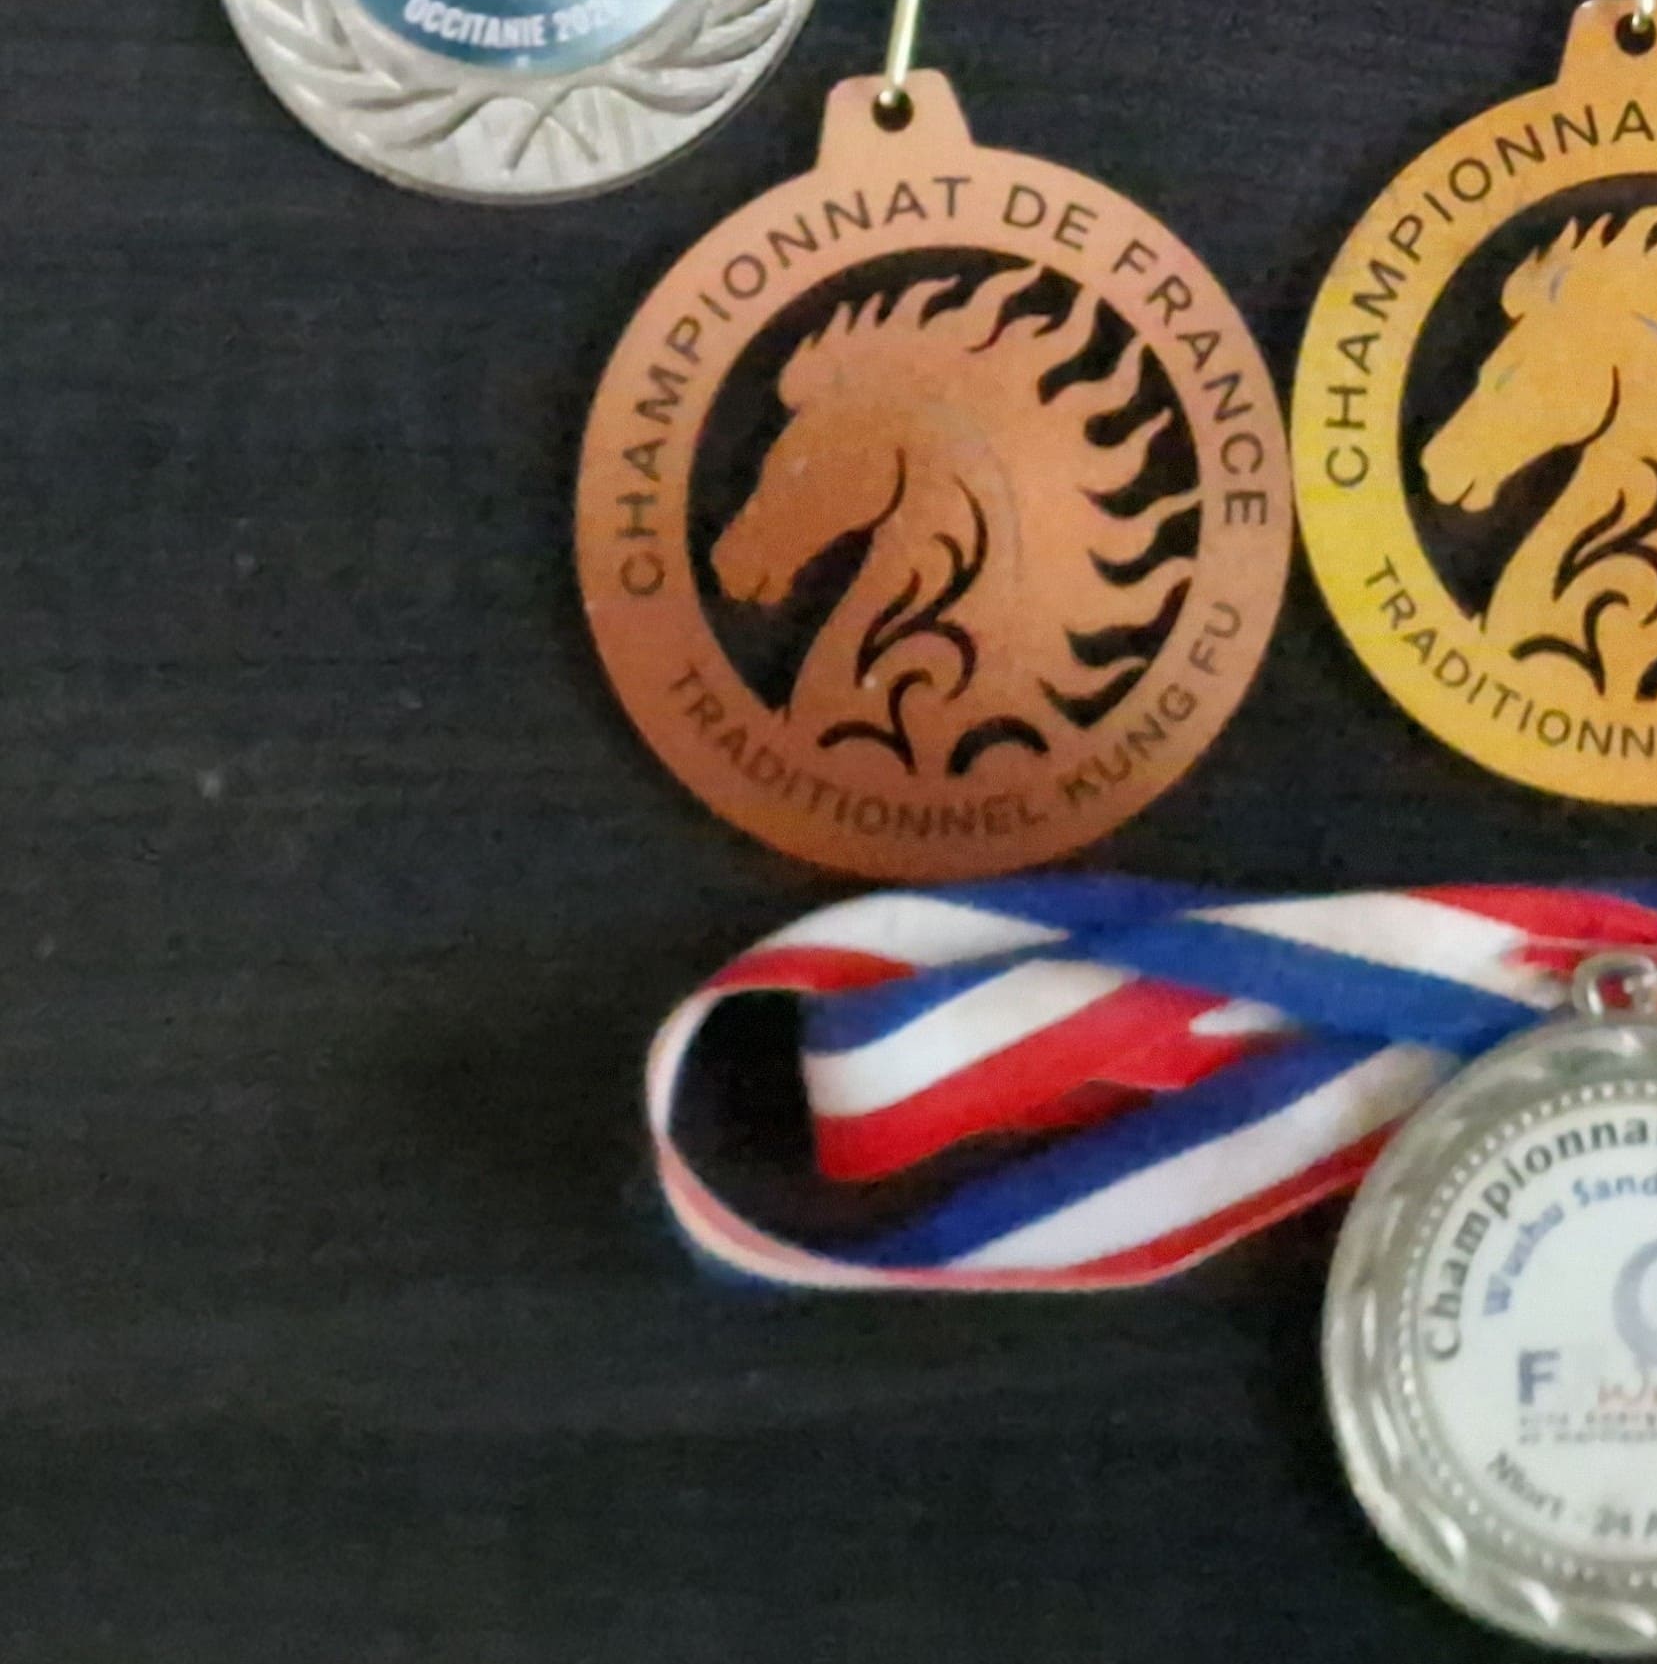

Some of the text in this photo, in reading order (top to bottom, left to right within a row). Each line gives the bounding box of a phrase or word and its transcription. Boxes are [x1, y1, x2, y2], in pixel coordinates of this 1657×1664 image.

[618, 175, 1269, 598] CHAMPIONNAT DE FRANCE
[667, 600, 1242, 841] TRADITIONNEL KUNG FU
[1480, 1201, 1567, 1319] Wushu
[1518, 1350, 1558, 1404] F
